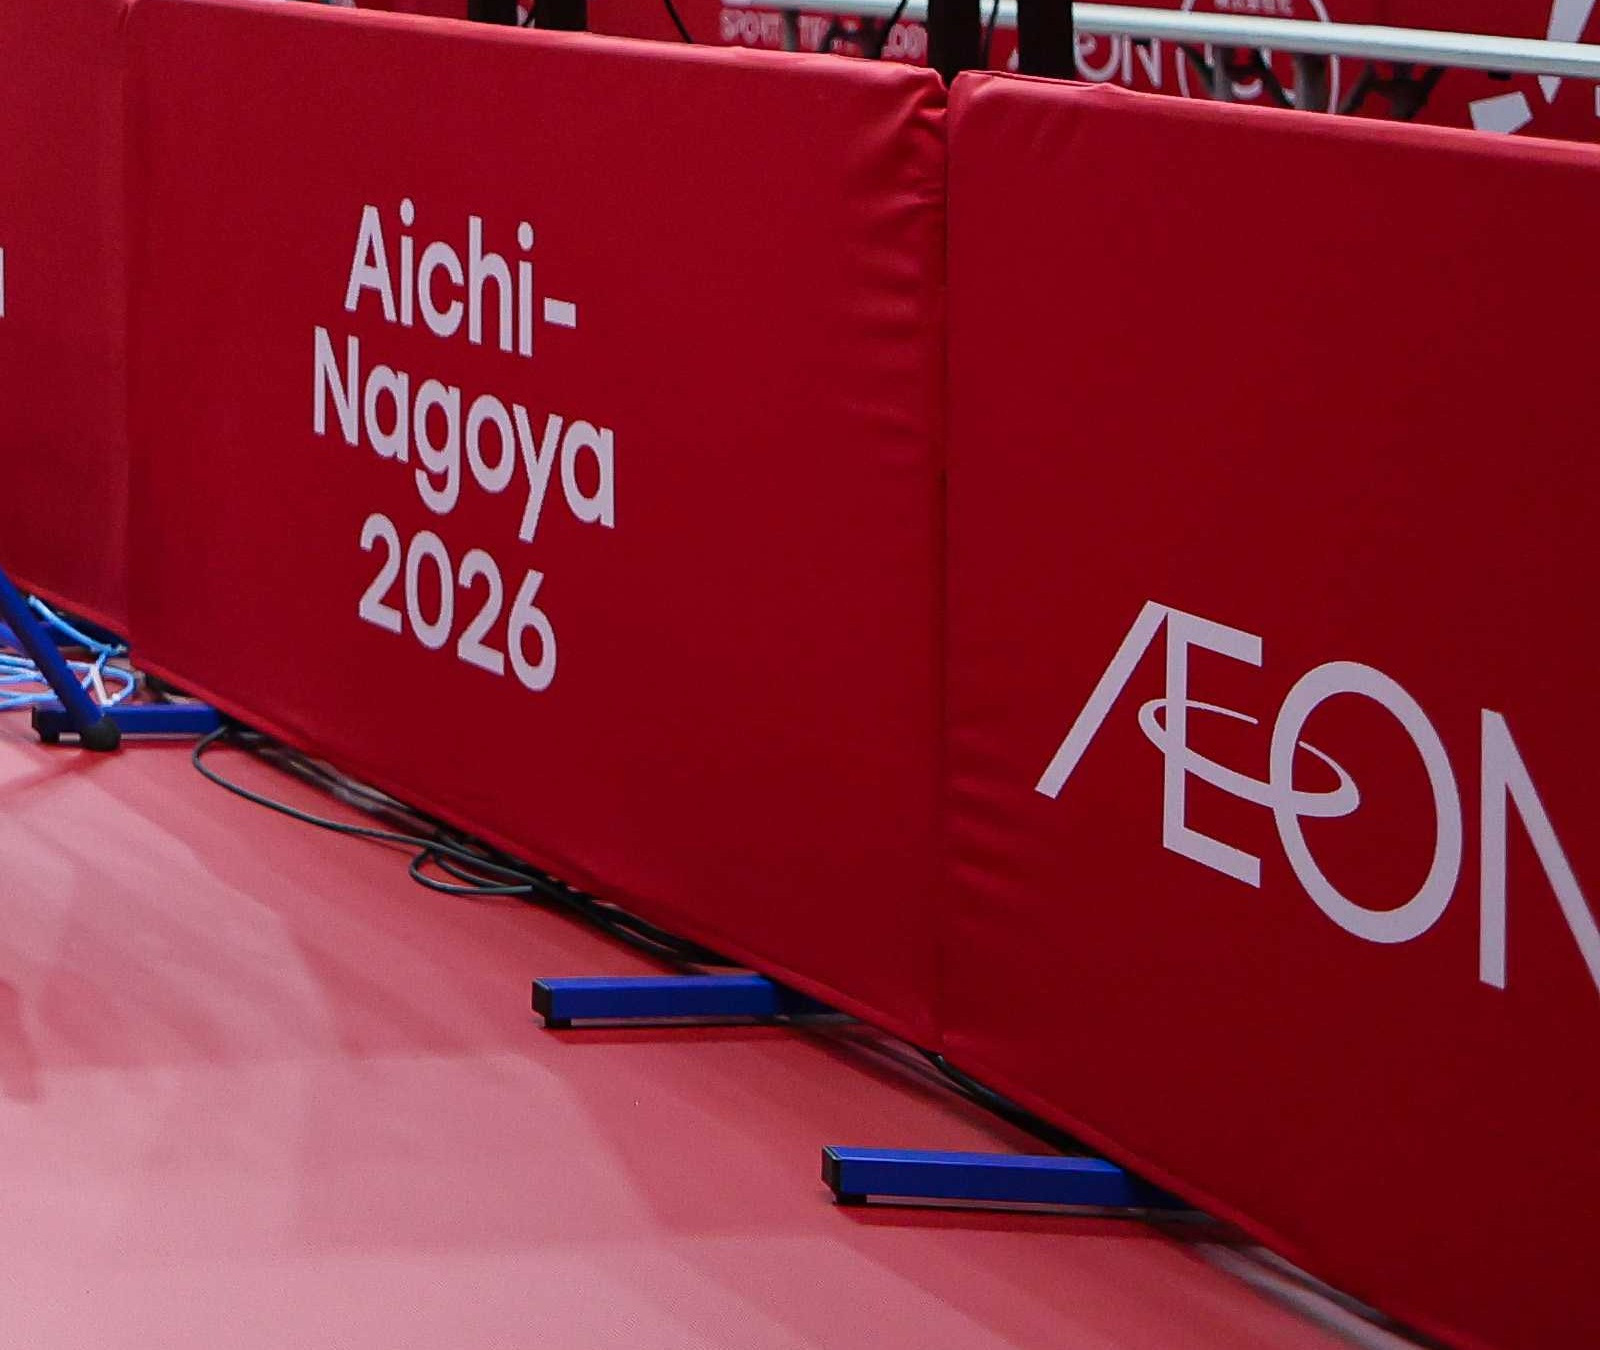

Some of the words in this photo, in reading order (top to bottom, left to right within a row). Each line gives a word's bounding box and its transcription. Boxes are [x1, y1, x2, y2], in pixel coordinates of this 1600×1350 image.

[343, 197, 578, 358] Aichi-
[313, 325, 616, 544] Nagoya
[358, 512, 558, 693] 2026
